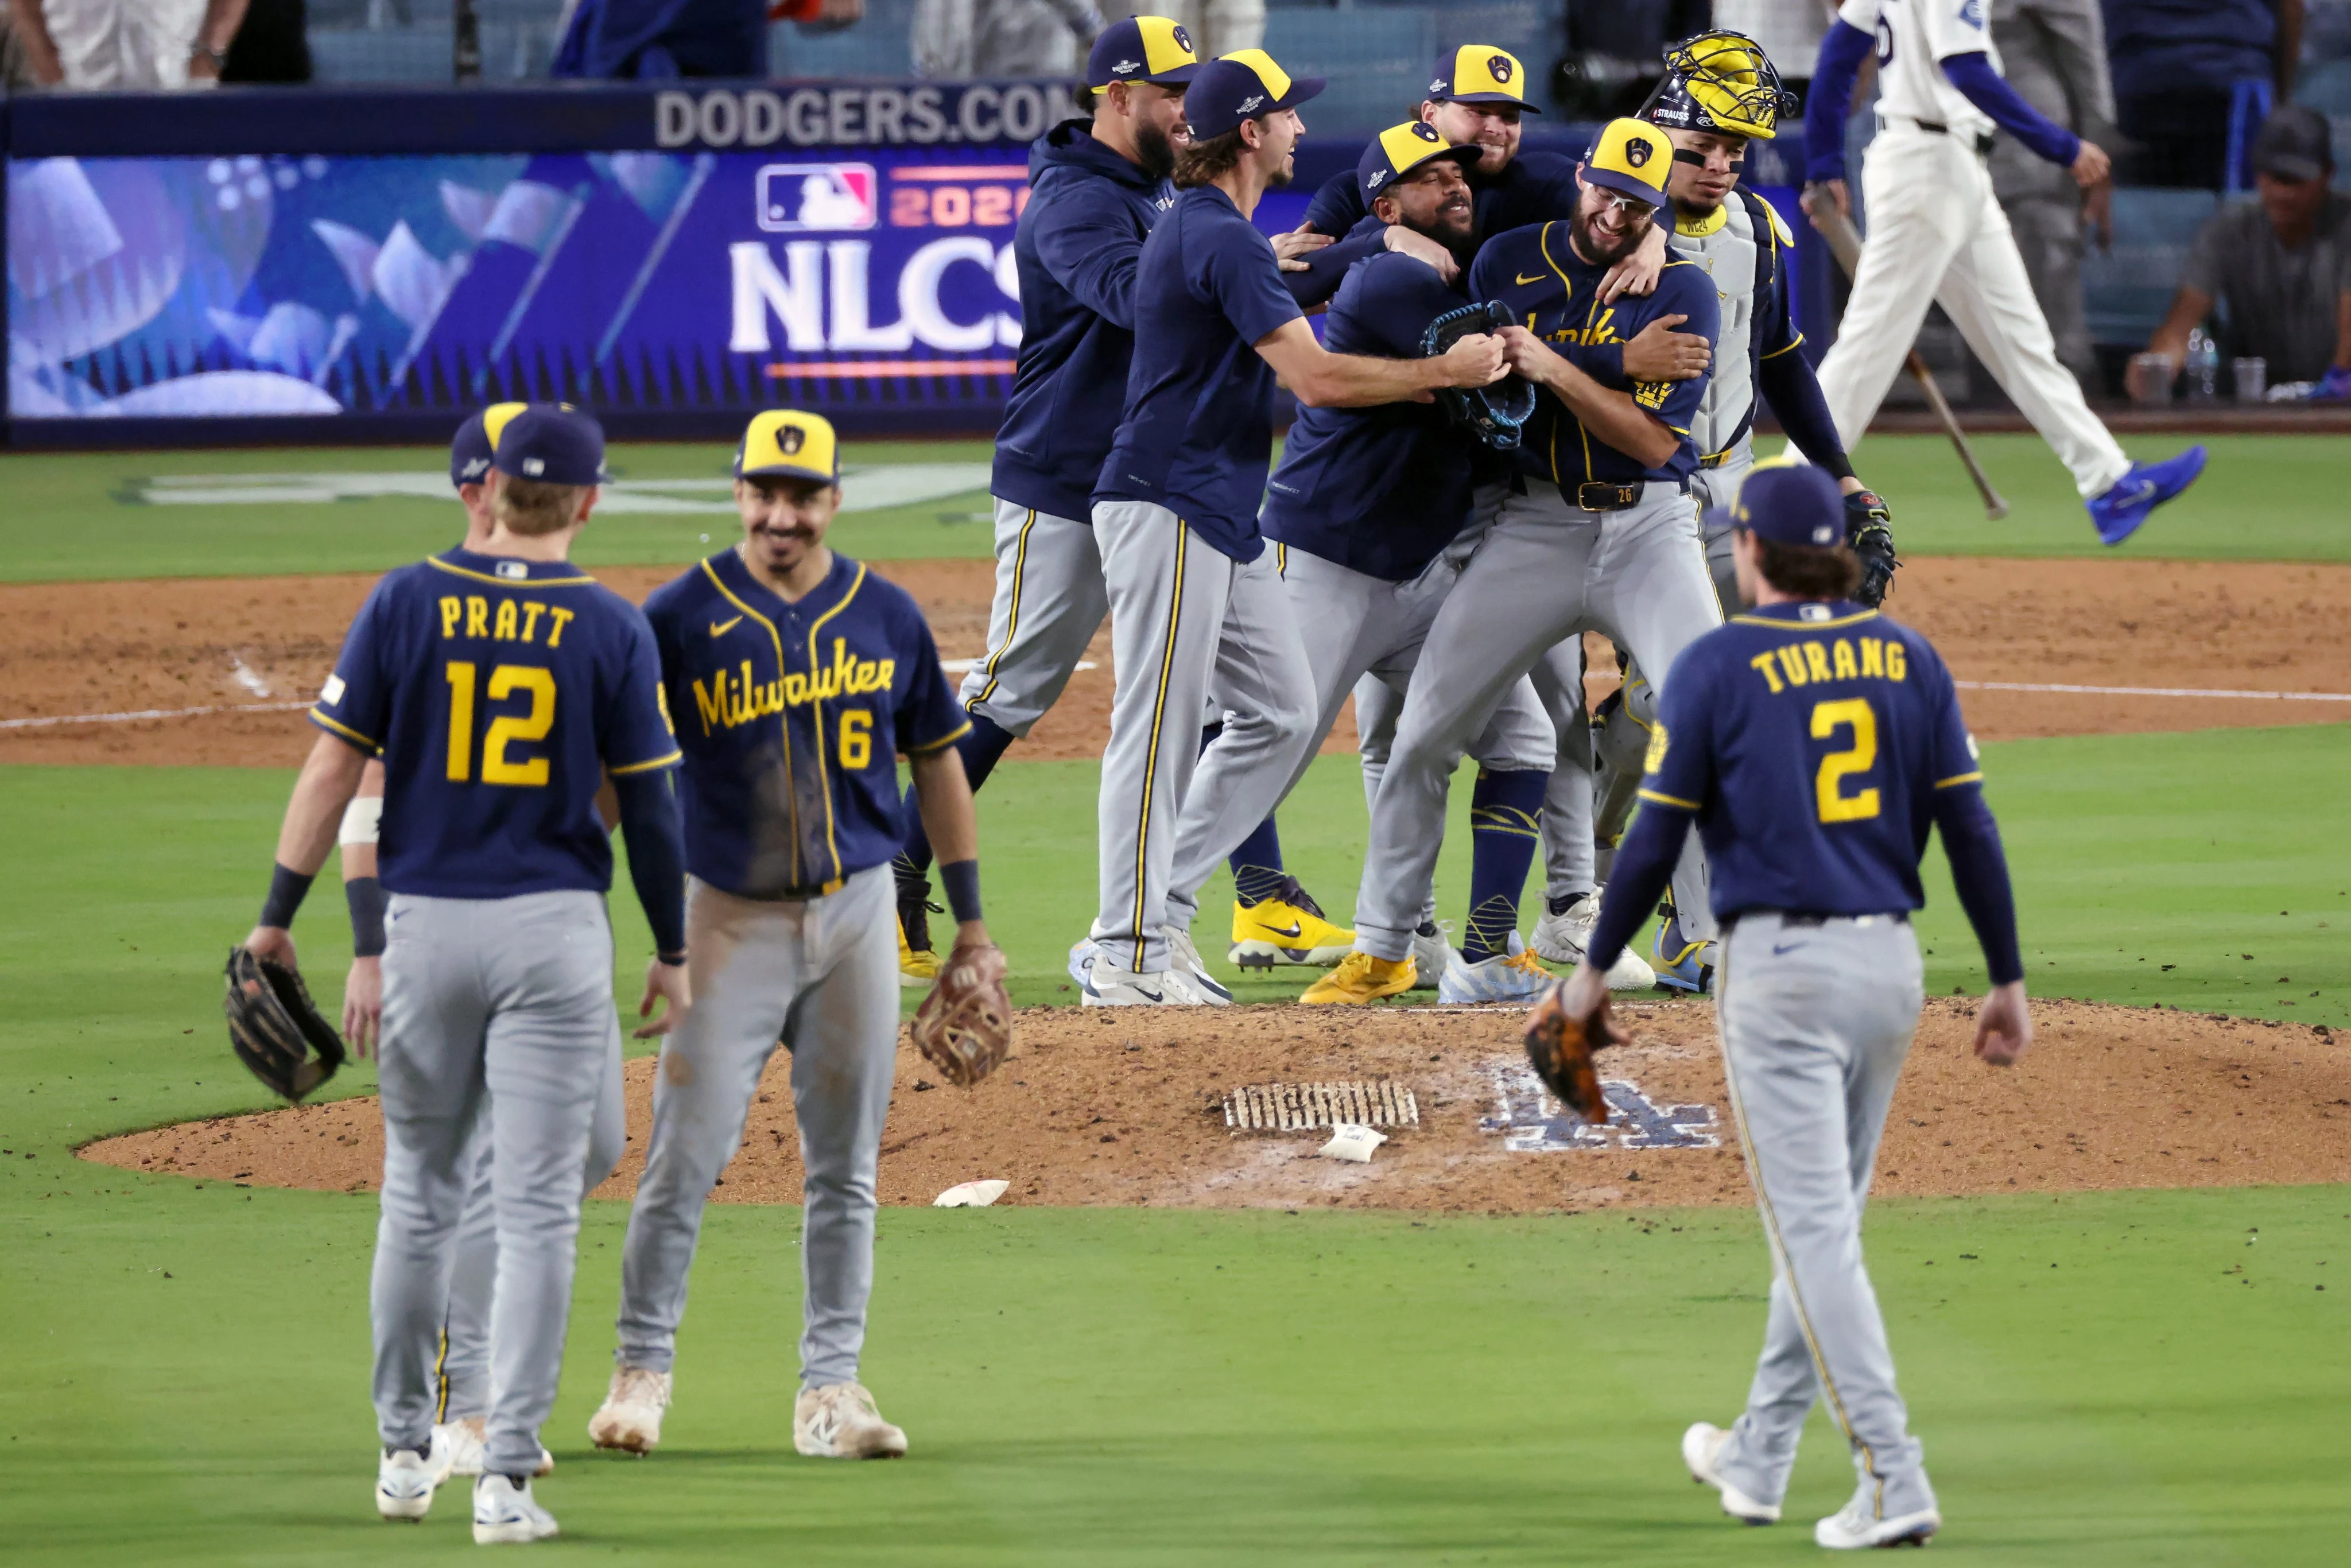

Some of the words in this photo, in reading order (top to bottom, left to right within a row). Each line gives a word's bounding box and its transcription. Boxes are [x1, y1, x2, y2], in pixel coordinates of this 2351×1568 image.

[1657, 108, 1690, 122] STRAUSS
[1618, 488, 1633, 503] 26
[439, 595, 575, 649] PRATT
[692, 636, 895, 738] Milwaukee
[1751, 636, 1907, 694] TURANG
[445, 660, 556, 786] 12
[837, 709, 873, 770] 6
[1809, 696, 1881, 825] 2
